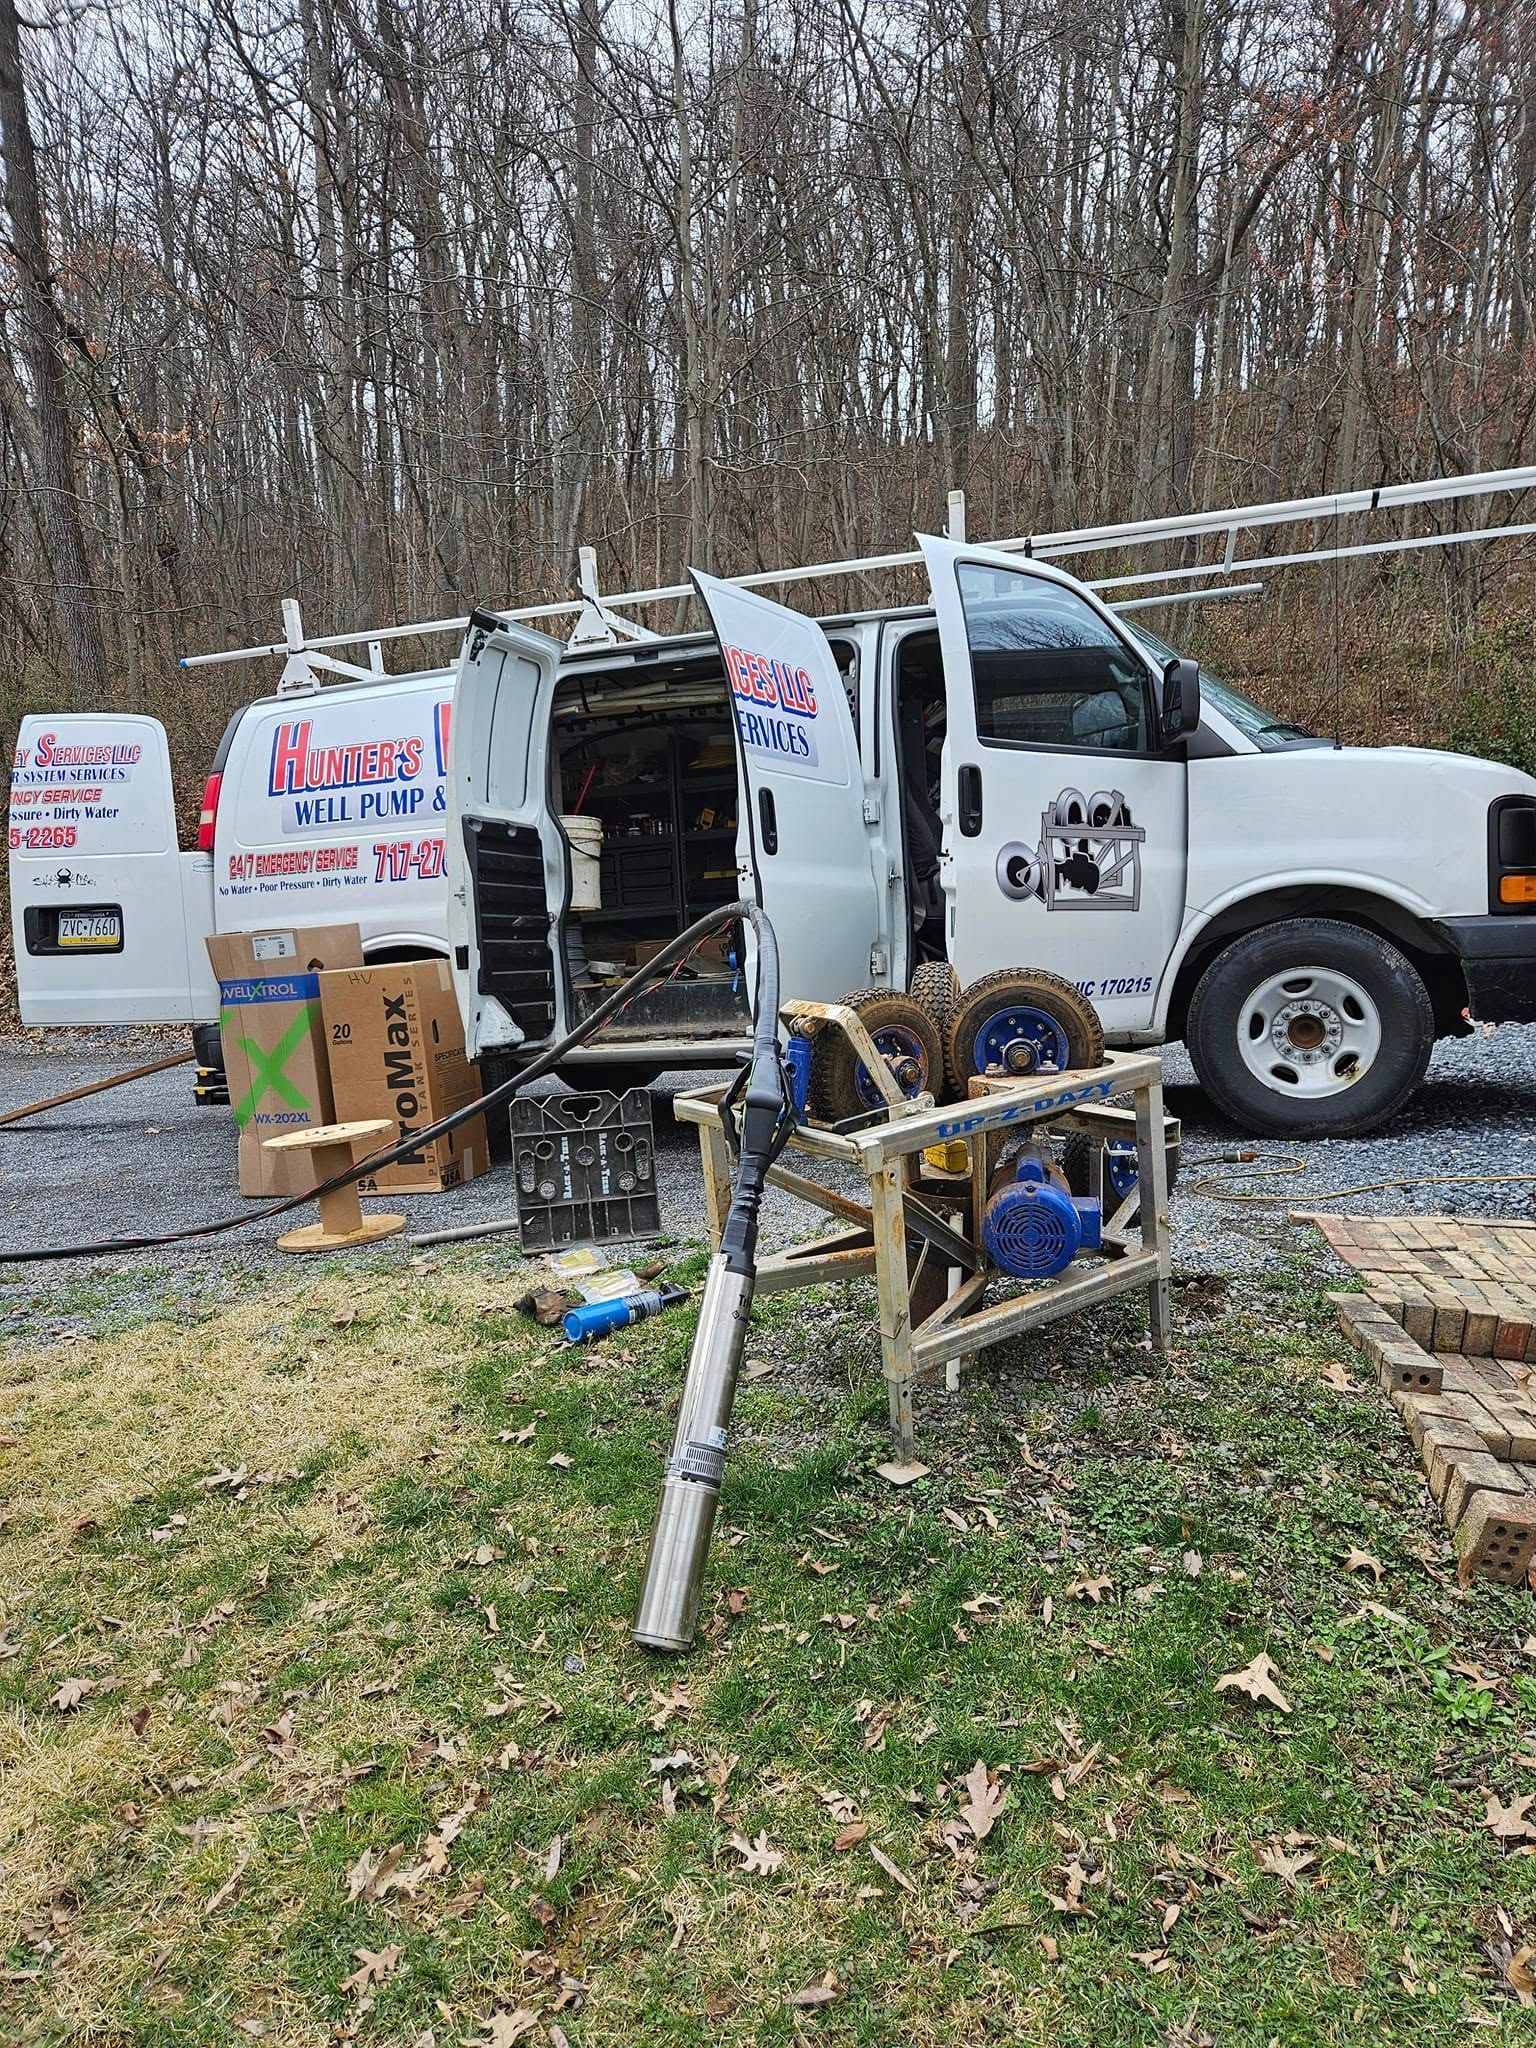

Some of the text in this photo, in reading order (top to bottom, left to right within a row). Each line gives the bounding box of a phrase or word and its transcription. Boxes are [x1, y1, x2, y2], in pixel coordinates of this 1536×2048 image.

[722, 643, 818, 719] ICES LLC
[36, 733, 113, 766] SERVICES
[112, 744, 141, 765] LLC
[268, 719, 424, 797] HUNTER'S
[24, 770, 66, 783] SYSTEM
[70, 768, 125, 781] SERVICES
[11, 789, 102, 805] NCY SERVICE
[295, 785, 447, 826] WELL PUMP &
[9, 806, 119, 822] ssure Dirty Water
[9, 827, 77, 849] 5-2265
[229, 838, 448, 883] 24/7 EMERGENCY SERVICE 717-27
[219, 875, 367, 896] No Water Poor Pressure Dirty Water
[1100, 977, 1153, 995] 170215
[402, 977, 421, 1047] SERIES
[333, 1023, 351, 1039] 20
[414, 1060, 428, 1112] TANK
[255, 1111, 311, 1124] WX-202XL
[936, 1080, 1115, 1138] UP-Z-DAZY
[357, 1179, 378, 1191] SA
